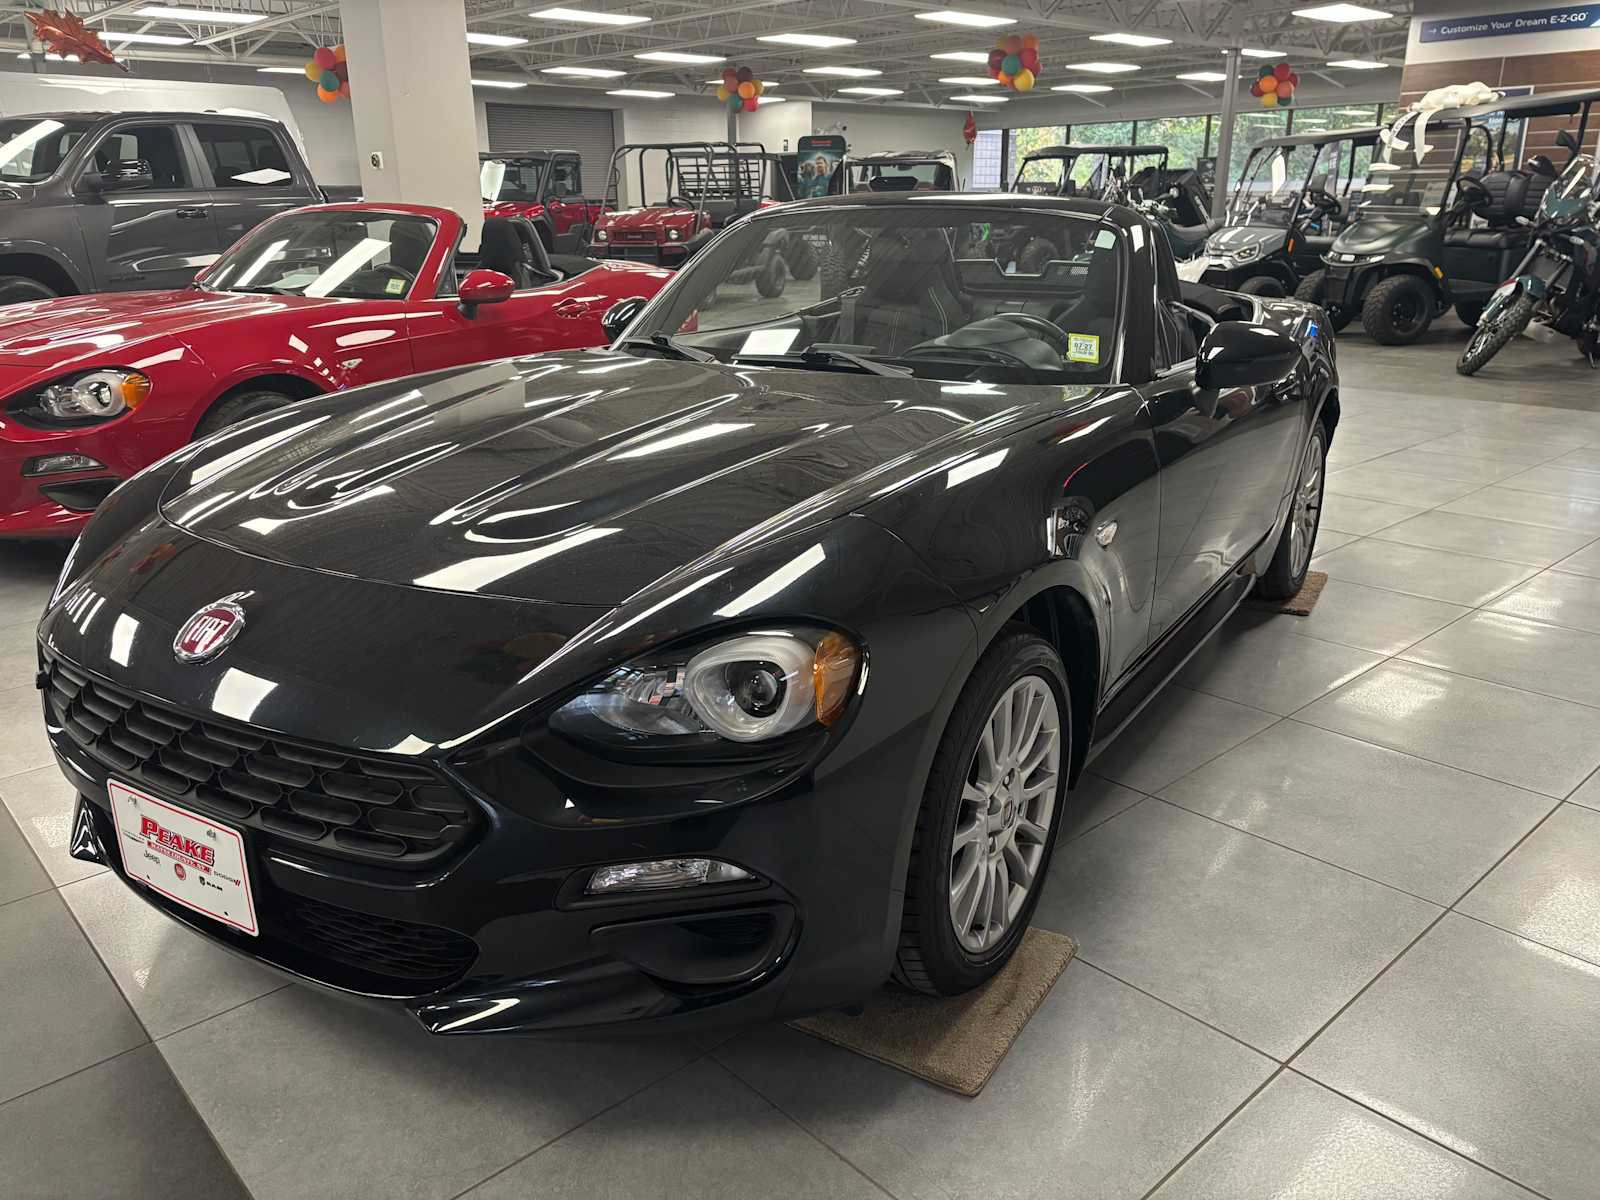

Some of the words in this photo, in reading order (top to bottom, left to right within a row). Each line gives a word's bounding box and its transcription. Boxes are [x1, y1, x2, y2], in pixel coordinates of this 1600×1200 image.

[1440, 23, 1488, 35] Customize
[1490, 21, 1513, 30] Your
[1515, 18, 1548, 28] Dream
[1550, 12, 1587, 24] E-Z-GO
[184, 615, 230, 648] FIAT
[140, 815, 215, 867] PEAKE
